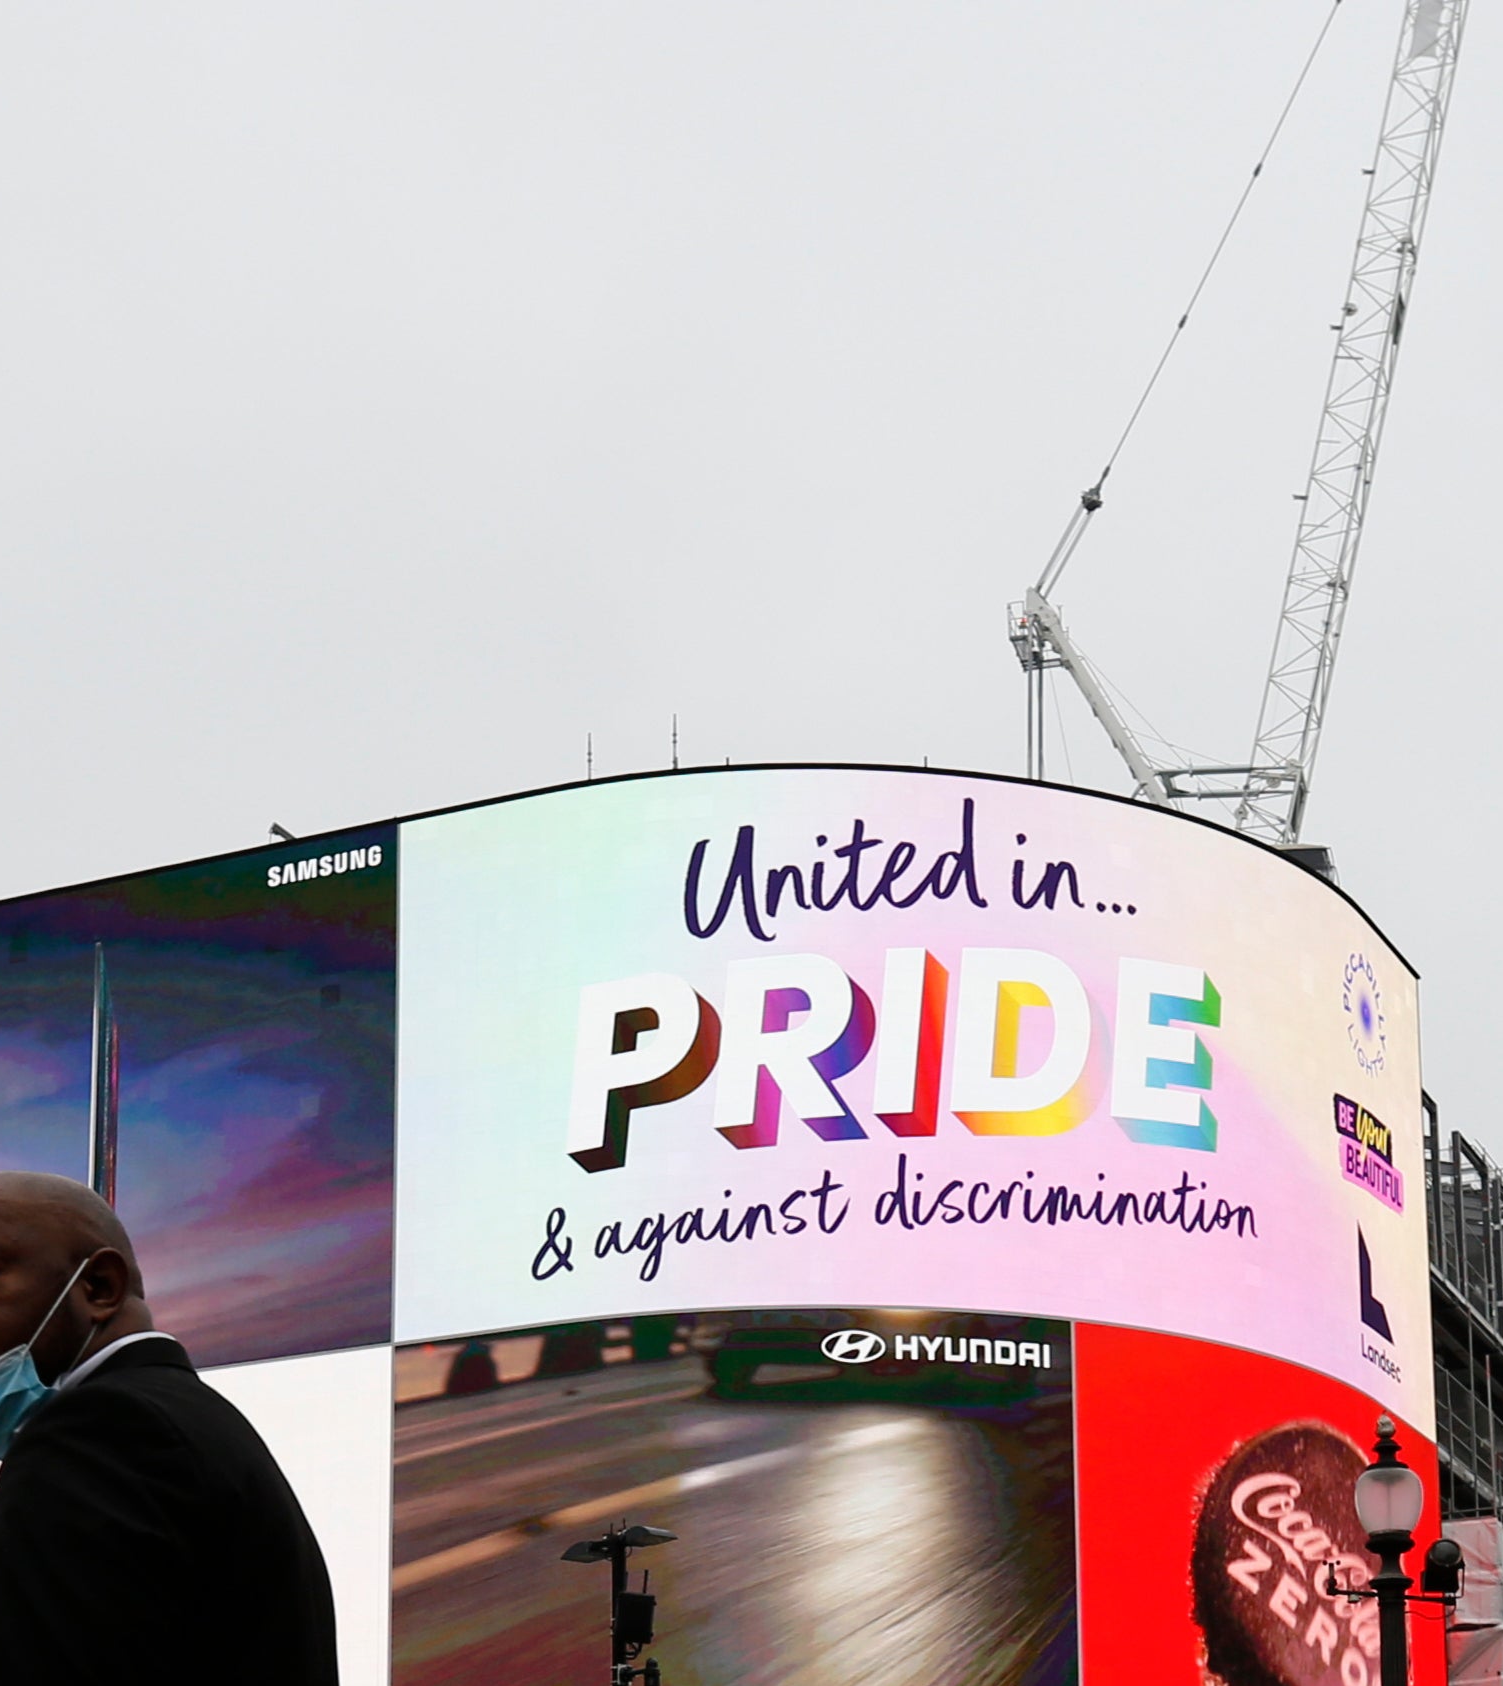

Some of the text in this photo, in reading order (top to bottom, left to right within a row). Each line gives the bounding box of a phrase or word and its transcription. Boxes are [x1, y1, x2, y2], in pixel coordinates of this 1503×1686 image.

[267, 845, 382, 888] SAMSUNG
[683, 797, 1138, 942] United in...
[567, 946, 1222, 1173] PRIDE
[1347, 1022, 1384, 1079] LIGHTS
[1338, 1100, 1356, 1133] BE
[1346, 1143, 1402, 1208] BEAUTIFUL
[531, 1152, 1259, 1281] & against discrimination
[894, 1334, 1051, 1369] HYUNDAI
[1361, 1332, 1402, 1384] Landsec
